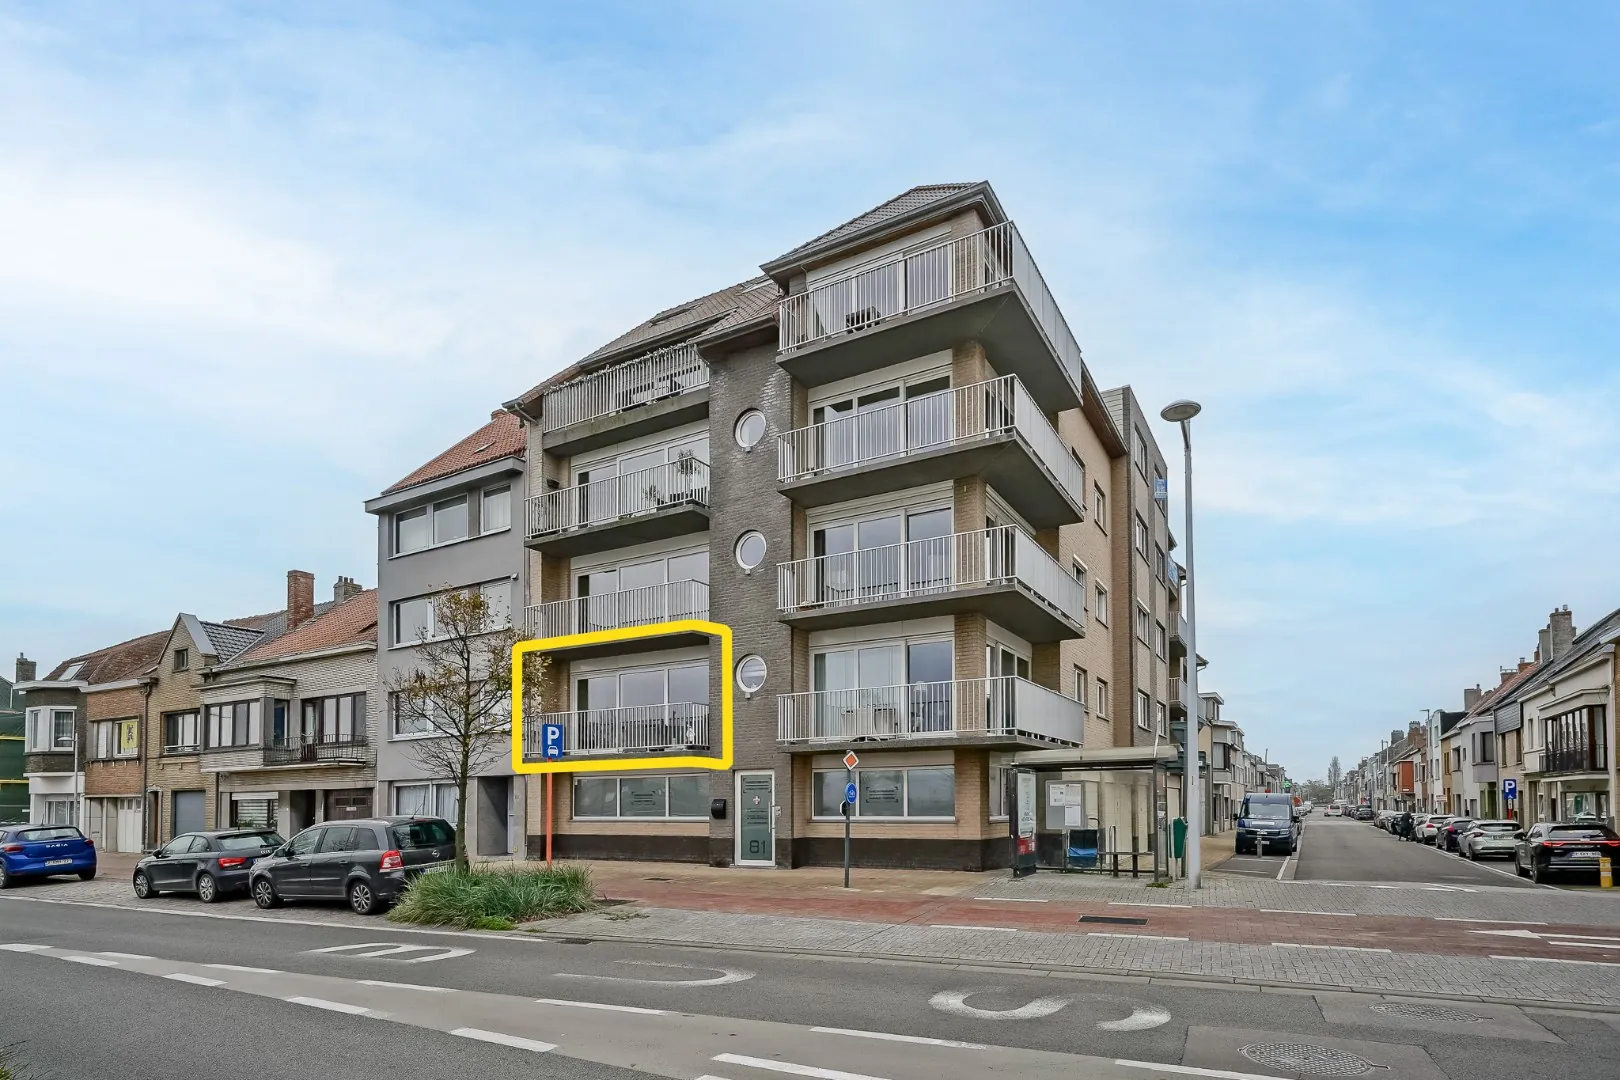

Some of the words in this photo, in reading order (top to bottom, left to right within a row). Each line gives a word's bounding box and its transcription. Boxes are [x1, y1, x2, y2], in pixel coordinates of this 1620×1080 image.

[547, 726, 560, 745] P
[1504, 780, 1516, 793] P
[749, 840, 766, 854] 81
